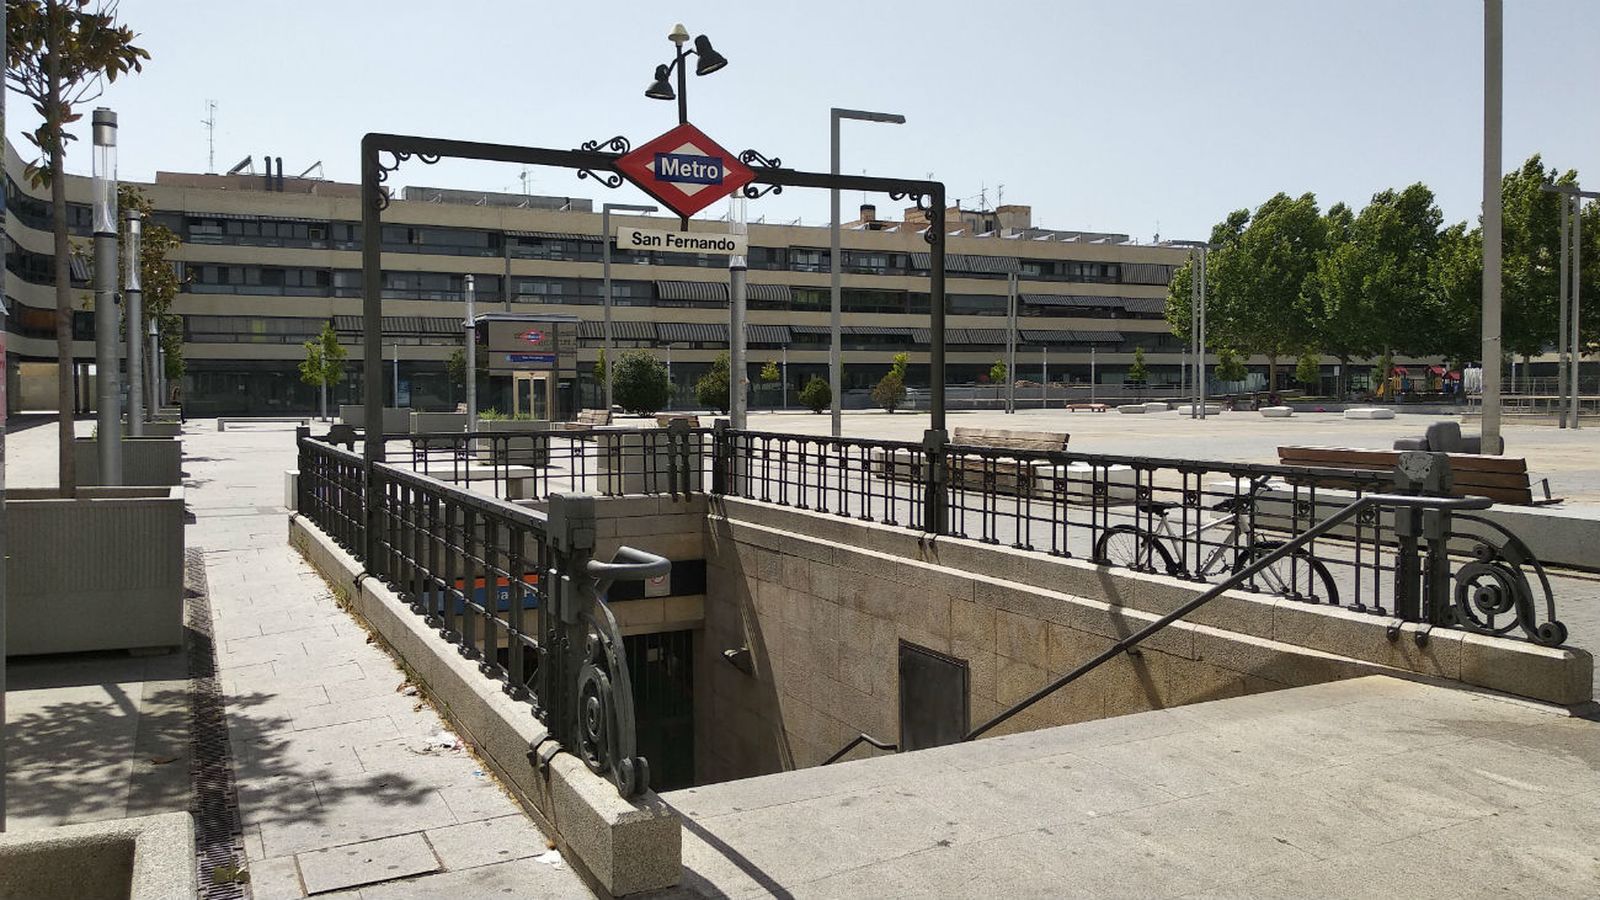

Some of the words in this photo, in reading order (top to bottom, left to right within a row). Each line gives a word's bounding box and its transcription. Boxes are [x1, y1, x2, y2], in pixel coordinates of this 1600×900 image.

[661, 157, 718, 179] Metro
[631, 231, 661, 246] San
[666, 233, 736, 251] Fernando
